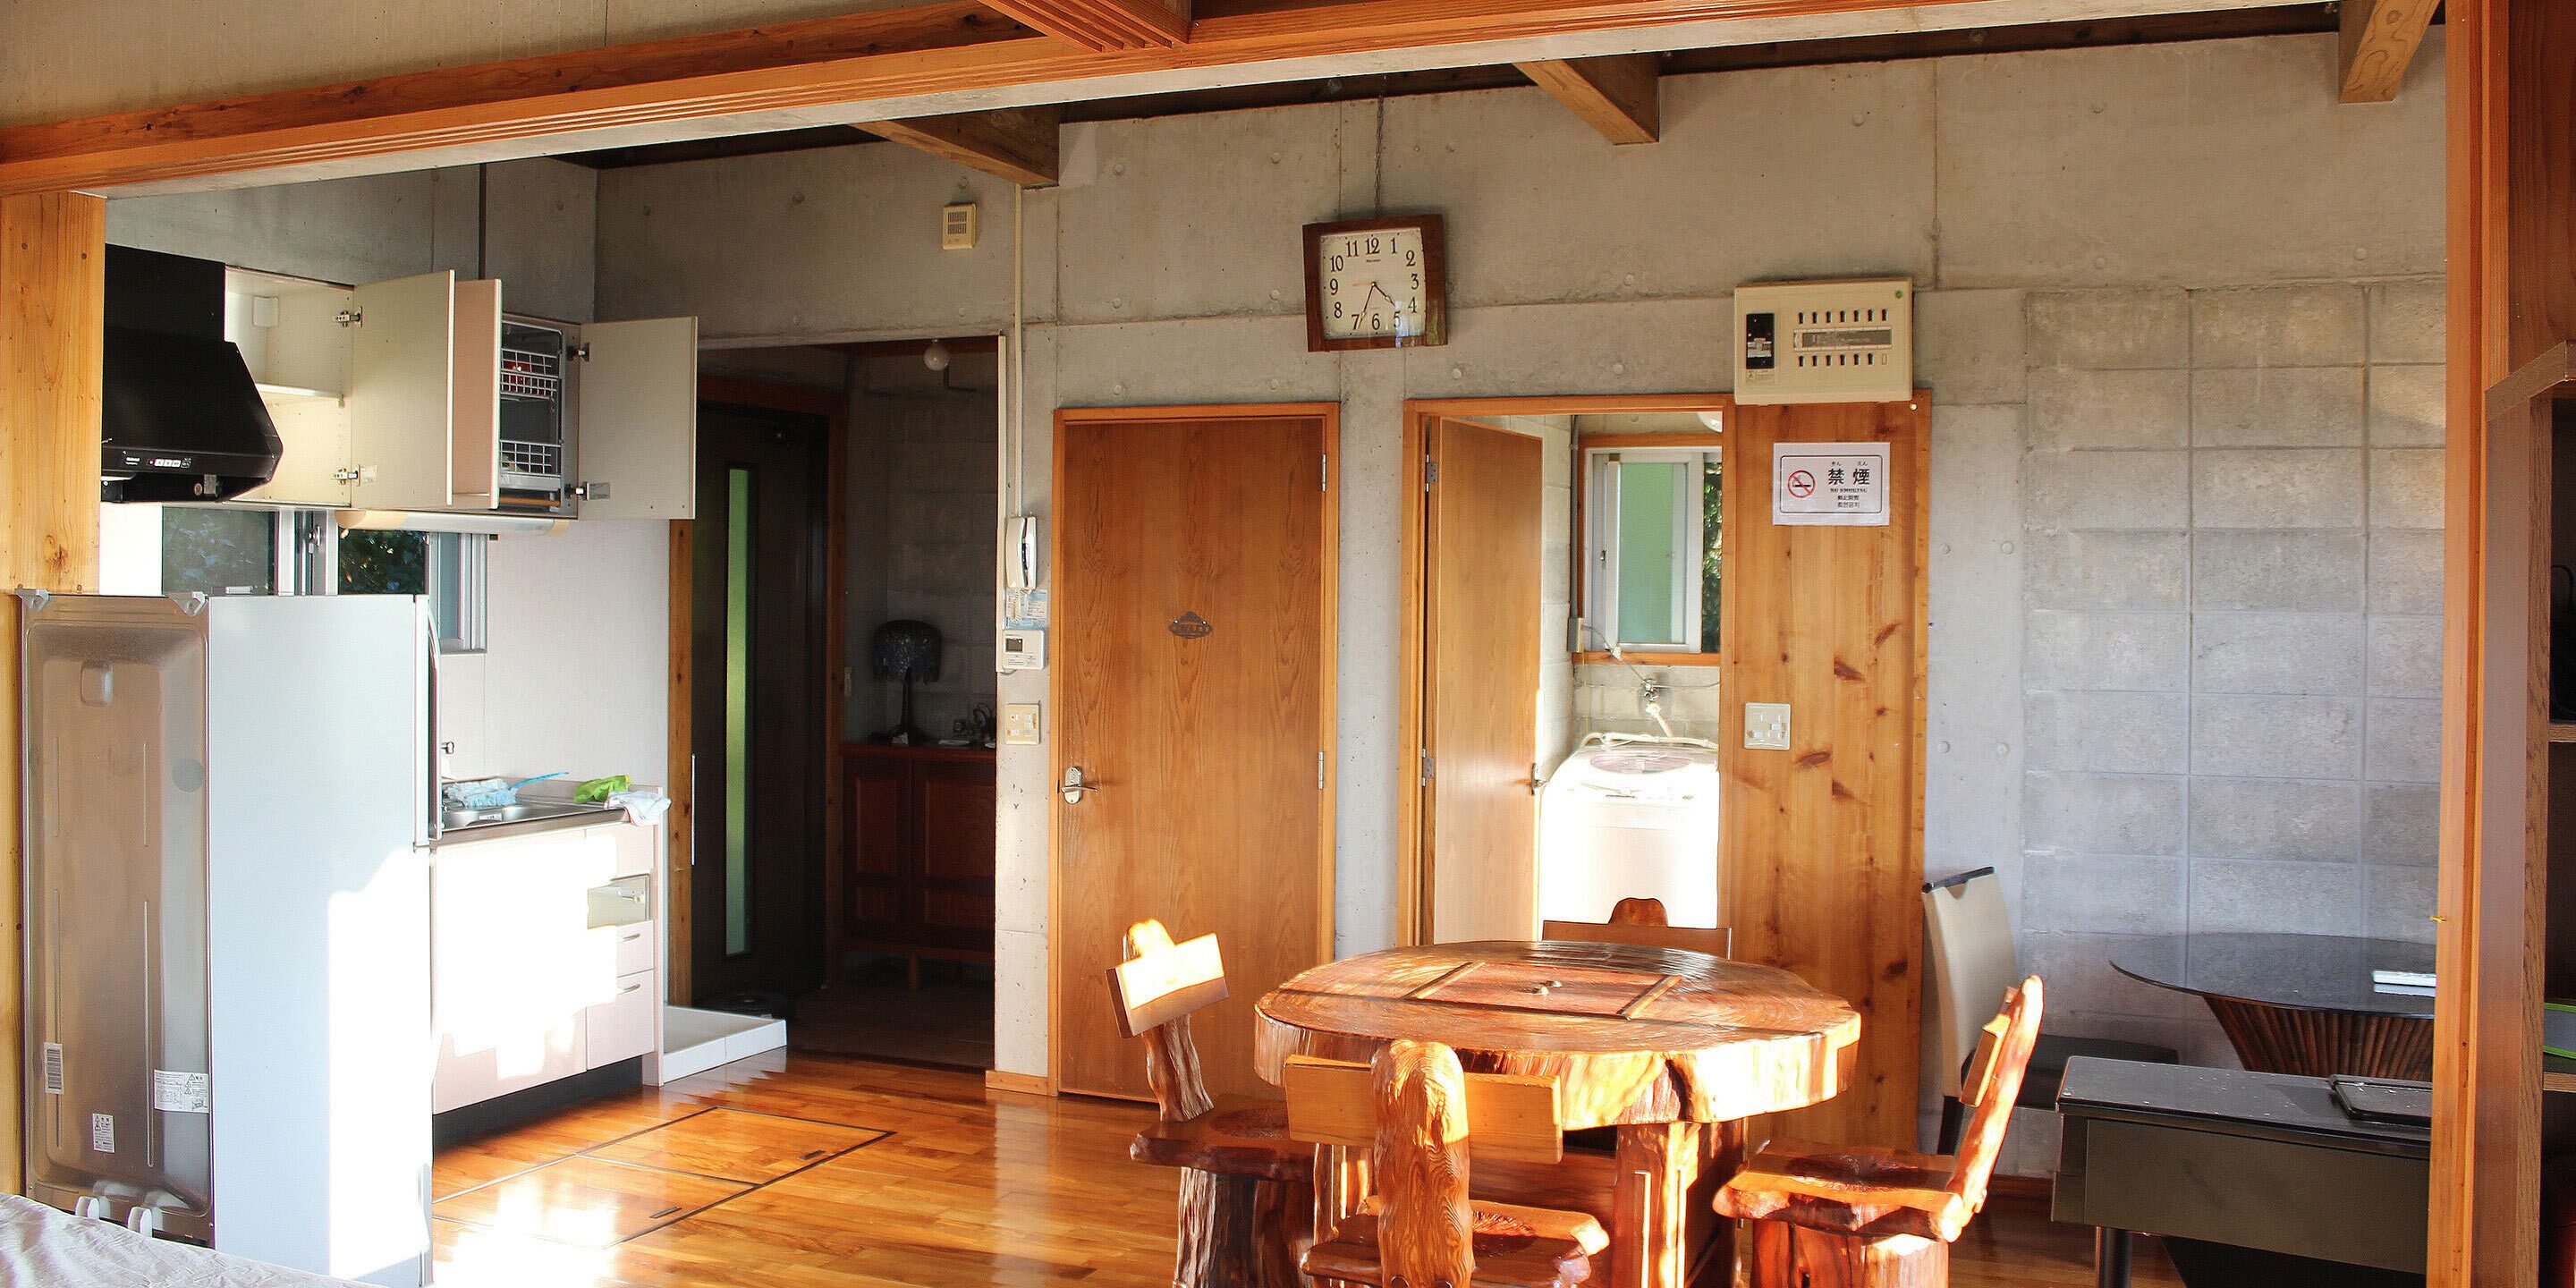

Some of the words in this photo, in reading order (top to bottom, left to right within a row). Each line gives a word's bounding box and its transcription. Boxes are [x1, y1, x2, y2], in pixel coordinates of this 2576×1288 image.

[1345, 240, 1359, 258] 11
[1365, 237, 1380, 255] 12
[1390, 237, 1397, 254] 1
[1330, 255, 1343, 272] 10
[1405, 250, 1416, 267] 2
[1329, 278, 1338, 295] 9
[1411, 273, 1419, 290] 3
[1334, 301, 1342, 318] 8
[1407, 296, 1417, 313] 4
[1351, 314, 1360, 330] 7
[1371, 313, 1380, 330] 6
[1393, 310, 1402, 327] 5
